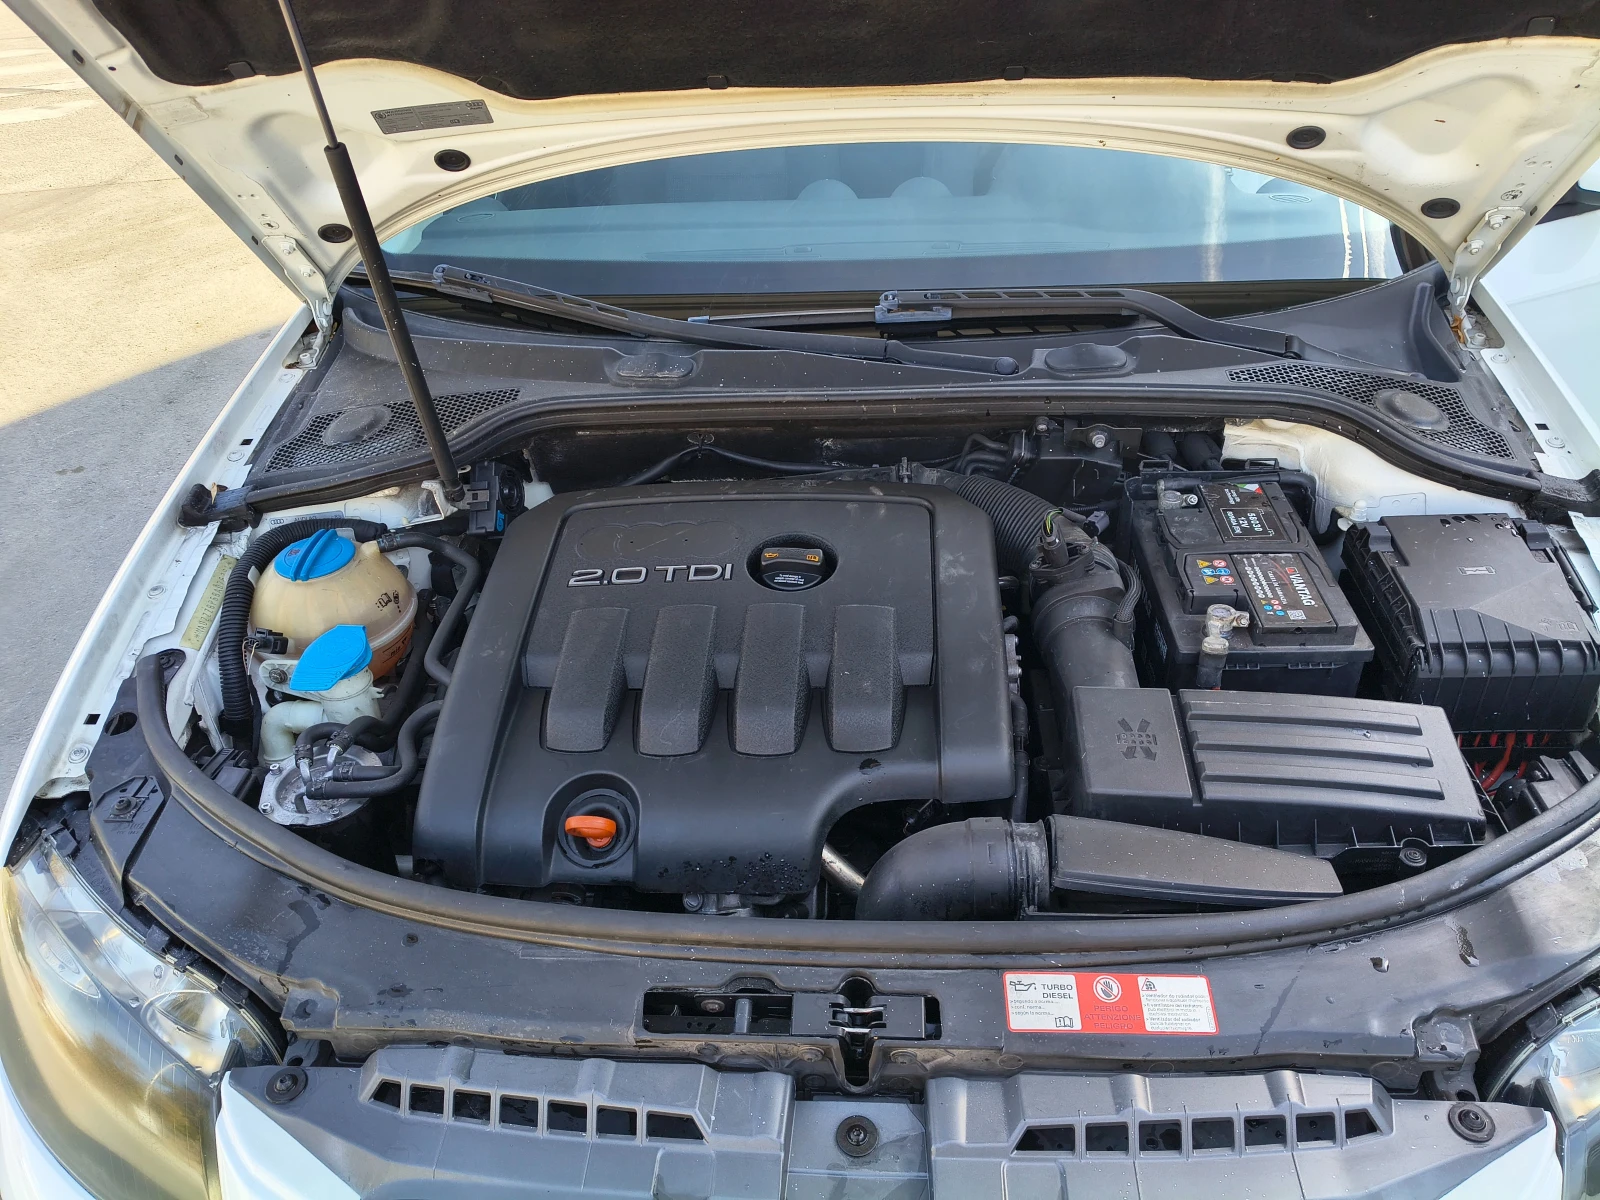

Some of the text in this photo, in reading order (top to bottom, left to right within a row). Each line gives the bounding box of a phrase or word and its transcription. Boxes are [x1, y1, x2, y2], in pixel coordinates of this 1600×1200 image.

[567, 563, 733, 587] 2.0 TDI
[1084, 1013, 1141, 1021] ATTENZIONE
